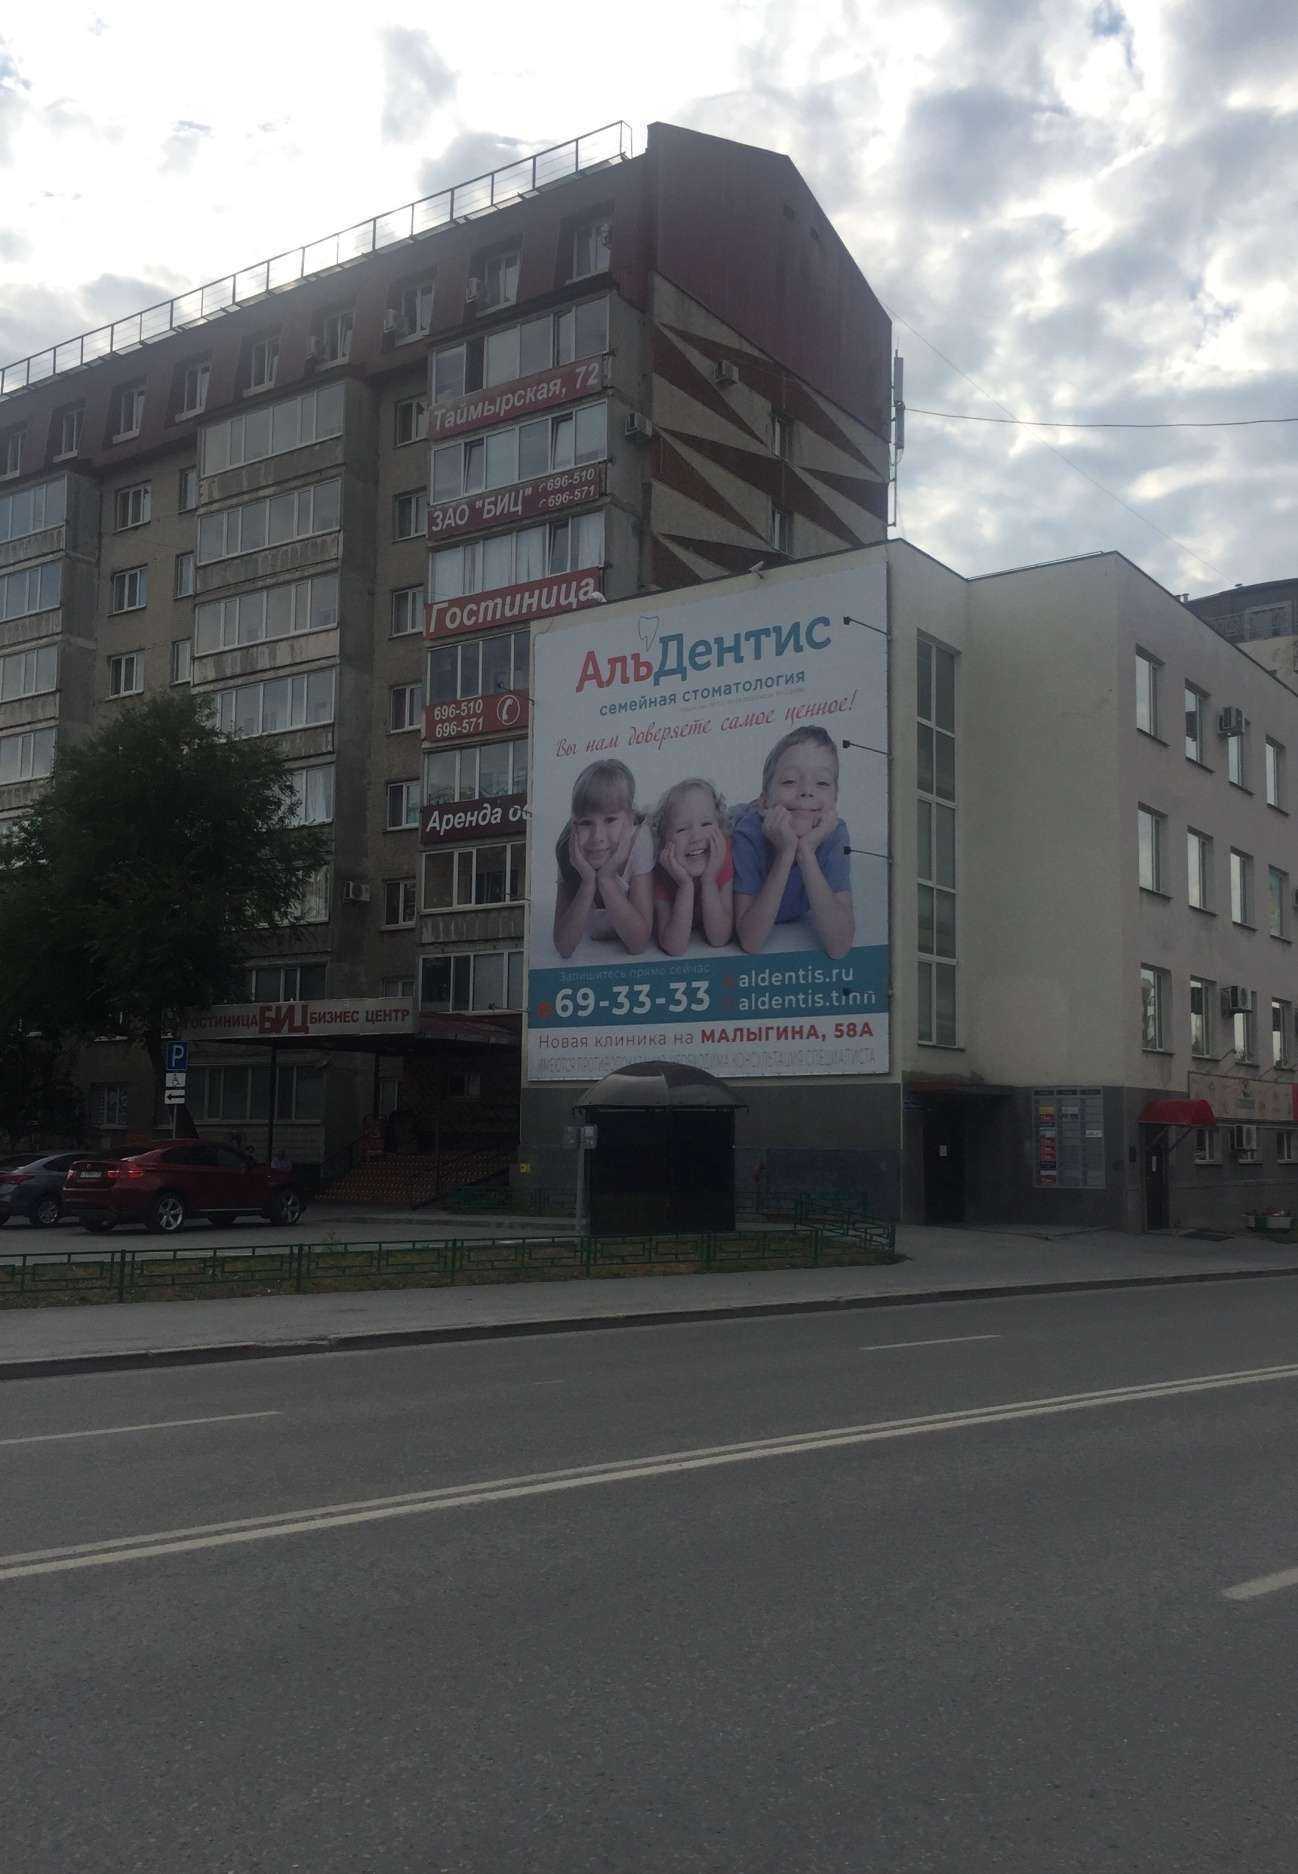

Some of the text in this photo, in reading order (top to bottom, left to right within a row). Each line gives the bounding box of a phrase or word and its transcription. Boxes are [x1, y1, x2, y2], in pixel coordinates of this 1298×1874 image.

[434, 362, 599, 431] Таймырская, 72
[547, 468, 595, 491] 696-510
[431, 487, 532, 532] ЗАО "БИЦ"
[548, 485, 595, 508] 696-571
[429, 577, 595, 633] Гостиница
[575, 616, 832, 693] АльДентис
[600, 692, 677, 716] семейная
[682, 670, 806, 703] стоматология
[434, 700, 484, 721] 696-510
[556, 738, 577, 757] Вы
[586, 734, 619, 753] нам
[627, 717, 712, 750] доверяете
[720, 708, 776, 732] самое
[784, 689, 859, 725] ценное!
[435, 717, 484, 738] 696-571
[426, 804, 502, 835] Аренда
[738, 965, 854, 988] aldentis.ru
[555, 981, 711, 1018] 69-33-33
[258, 1003, 310, 1034] БИЦ
[310, 1009, 359, 1024] БИЗНЕС
[365, 1008, 410, 1023] ЦЕНТР
[539, 1034, 589, 1050] Новая
[594, 1032, 667, 1049] клиника
[673, 1033, 694, 1046] на
[701, 1024, 827, 1045] МАЛЫГИНА,
